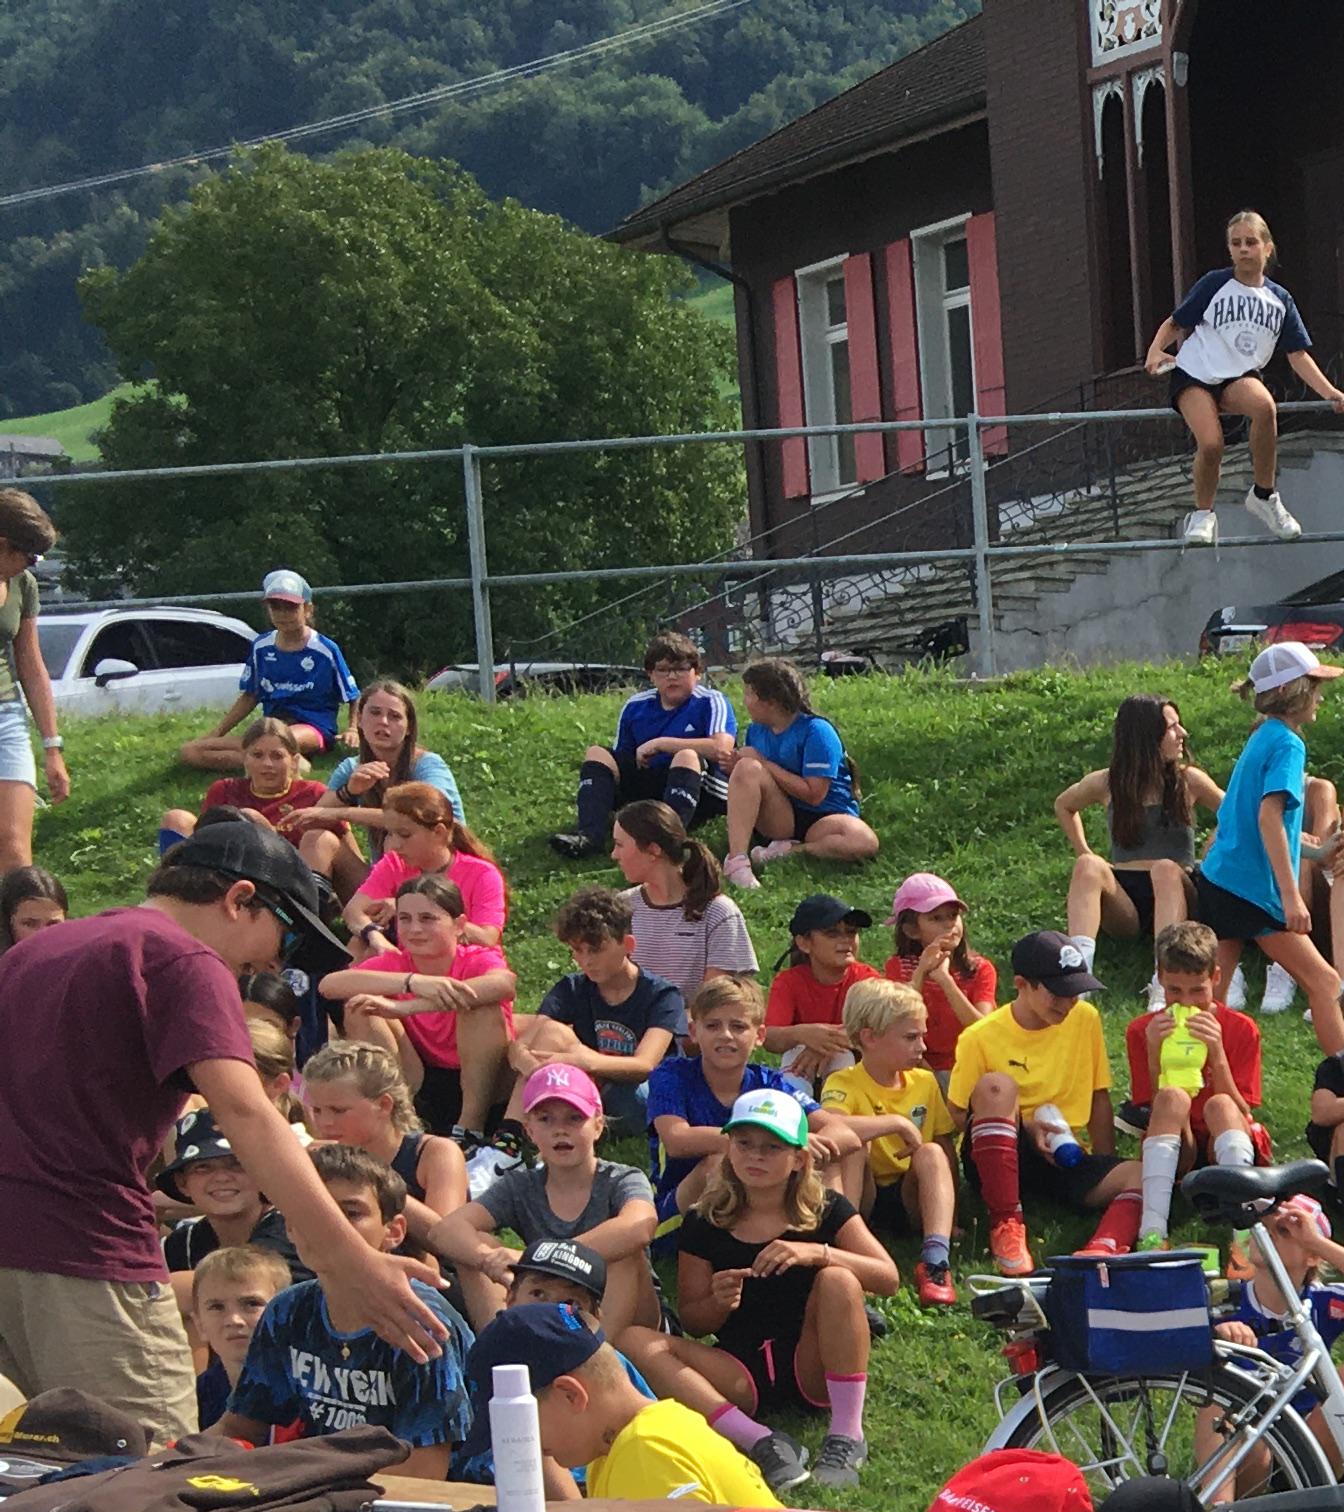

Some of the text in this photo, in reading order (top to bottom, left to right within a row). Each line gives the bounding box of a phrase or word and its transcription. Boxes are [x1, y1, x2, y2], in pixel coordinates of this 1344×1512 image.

[1213, 295, 1286, 337] HARVARD
[546, 1069, 569, 1086] NY
[552, 1249, 593, 1275] KINGDOM
